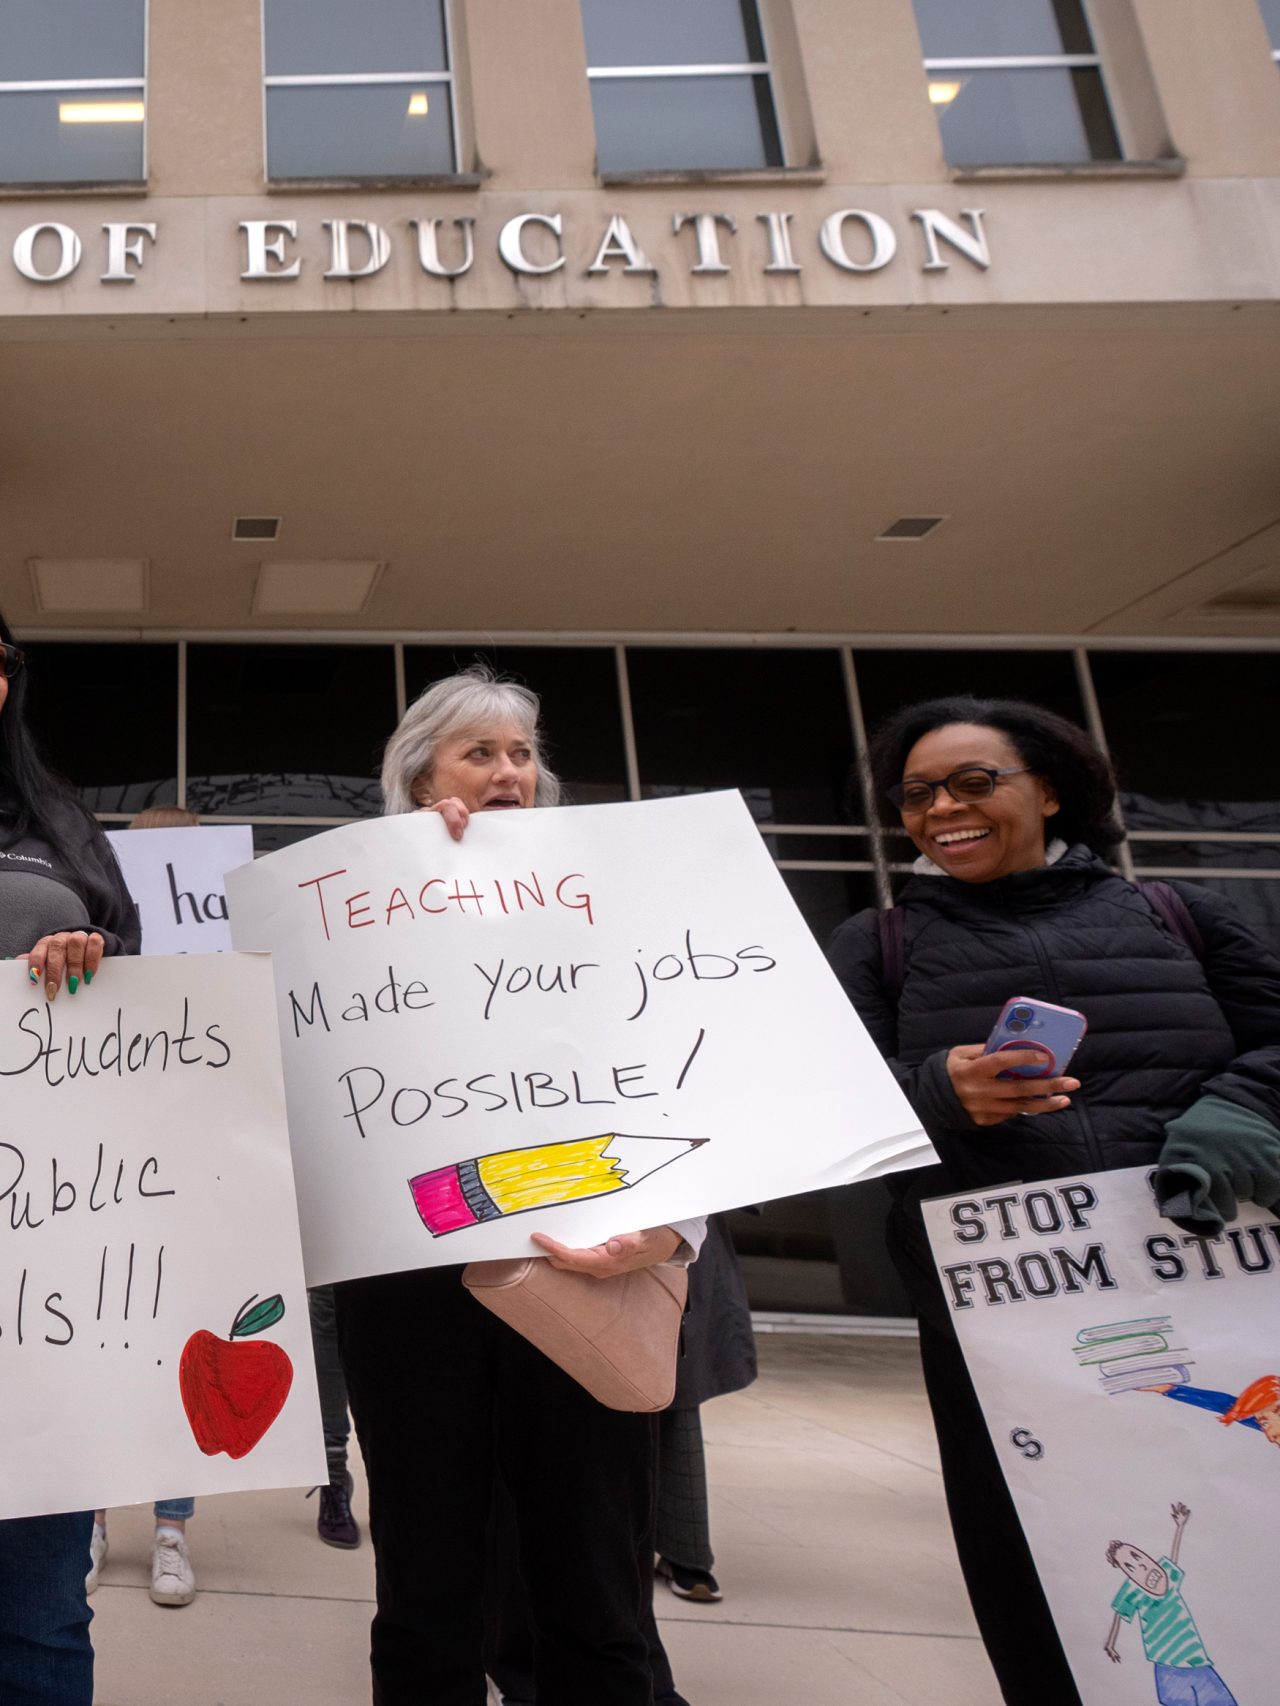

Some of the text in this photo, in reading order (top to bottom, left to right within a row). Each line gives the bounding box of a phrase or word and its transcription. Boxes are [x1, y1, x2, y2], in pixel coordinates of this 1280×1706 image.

[12, 220, 158, 283] OF
[238, 206, 992, 281] EDUCATION
[7, 853, 52, 869] Columbia
[298, 868, 595, 941] TEACHING
[288, 929, 777, 1038] Made your jobs
[337, 1027, 706, 1138] POSSIBLE!
[948, 1181, 1100, 1245] STOP
[941, 1242, 1119, 1310] FROM
